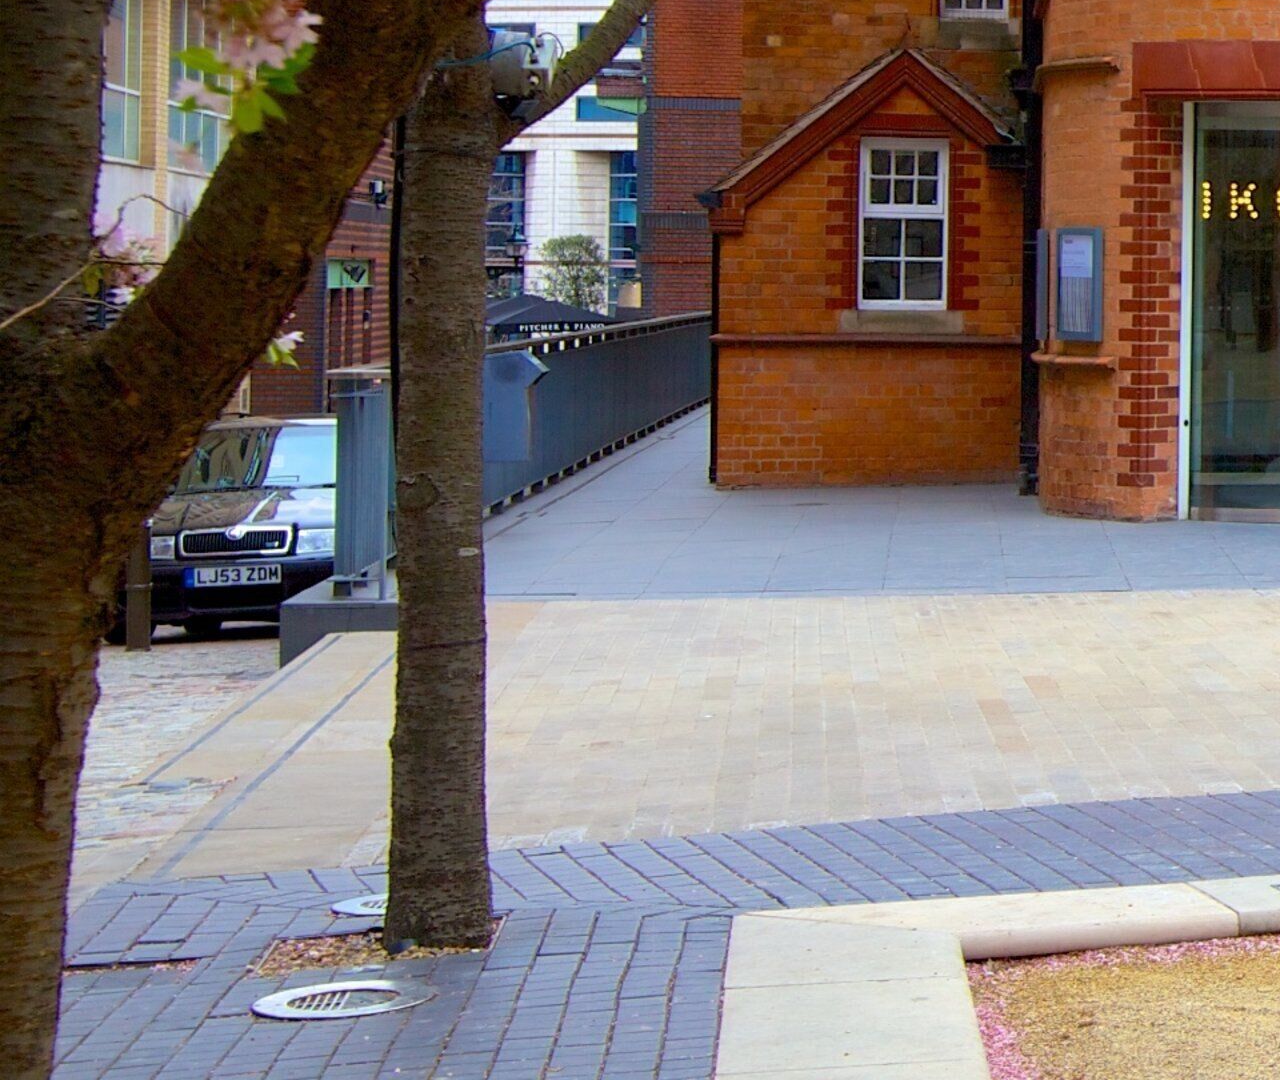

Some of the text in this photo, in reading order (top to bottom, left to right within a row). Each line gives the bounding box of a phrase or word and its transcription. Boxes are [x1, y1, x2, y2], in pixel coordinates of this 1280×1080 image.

[519, 323, 560, 332] PITCHER
[574, 322, 605, 331] PIANO
[196, 566, 280, 585] LJ53 ZDM
